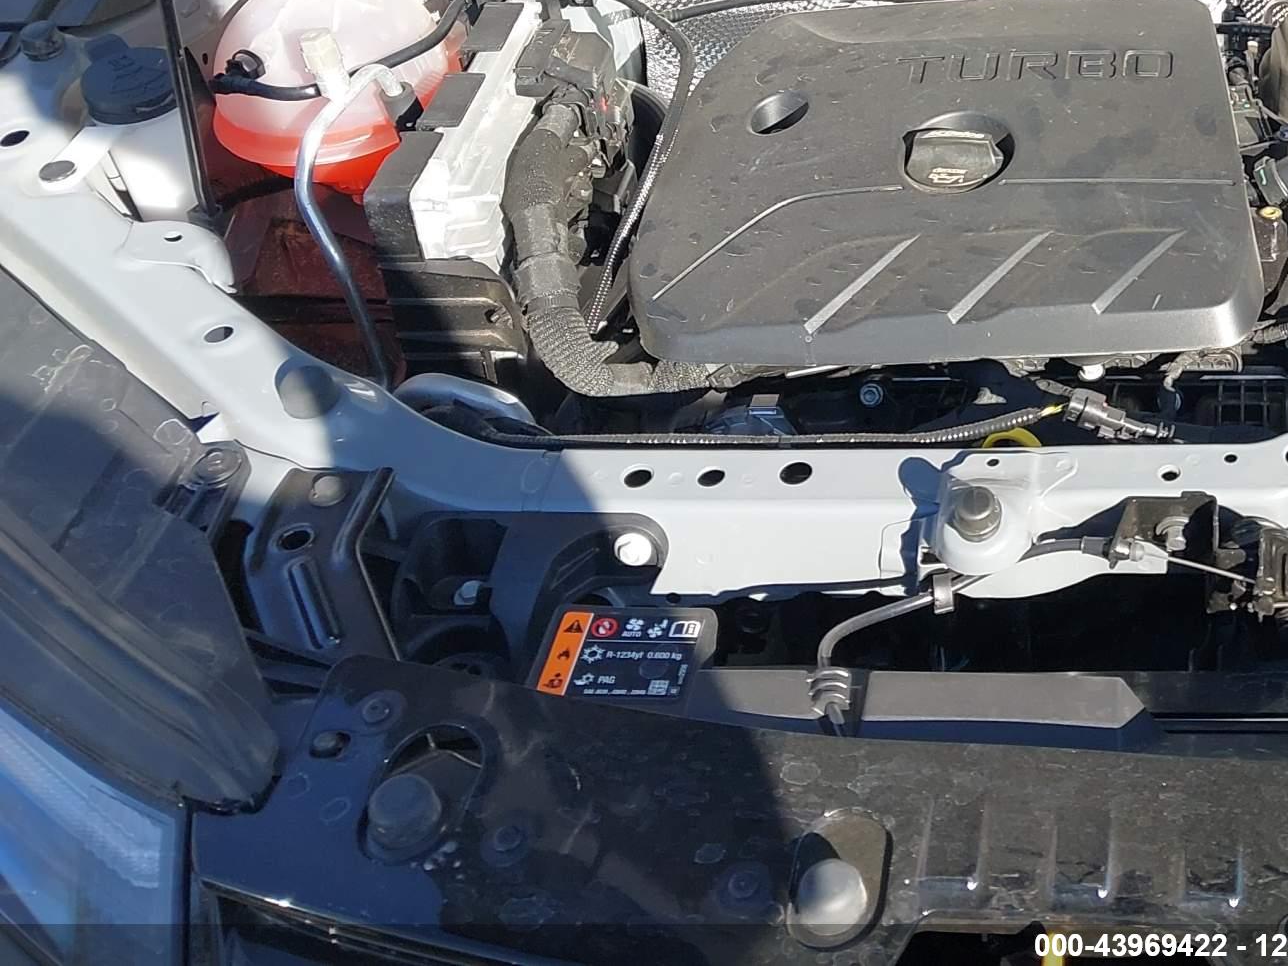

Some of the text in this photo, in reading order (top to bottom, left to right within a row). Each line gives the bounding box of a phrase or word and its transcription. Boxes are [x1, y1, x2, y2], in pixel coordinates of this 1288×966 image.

[896, 49, 1174, 84] TURBO
[621, 630, 642, 638] AUTO
[671, 651, 683, 661] kg
[597, 675, 616, 684] PAG
